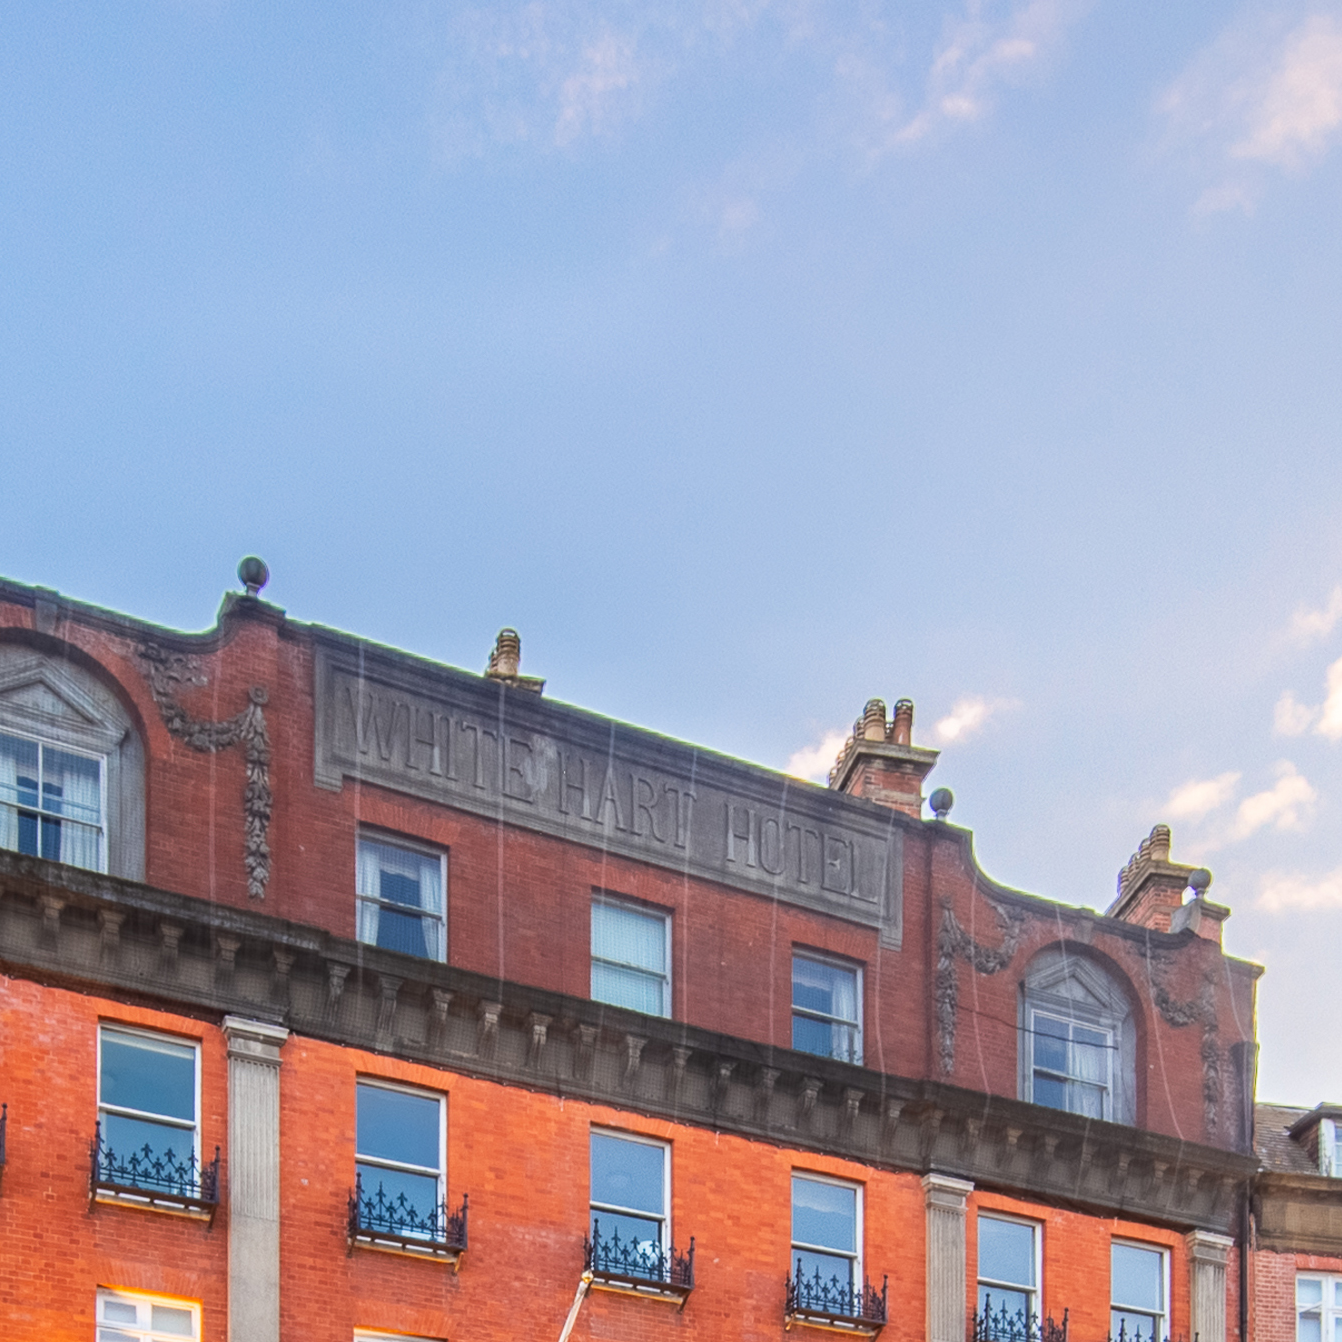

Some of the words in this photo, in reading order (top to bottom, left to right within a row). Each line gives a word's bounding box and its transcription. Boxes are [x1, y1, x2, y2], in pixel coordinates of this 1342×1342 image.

[345, 686, 534, 805] WHITE
[557, 751, 698, 850] HART
[724, 801, 880, 906] HOTEL
